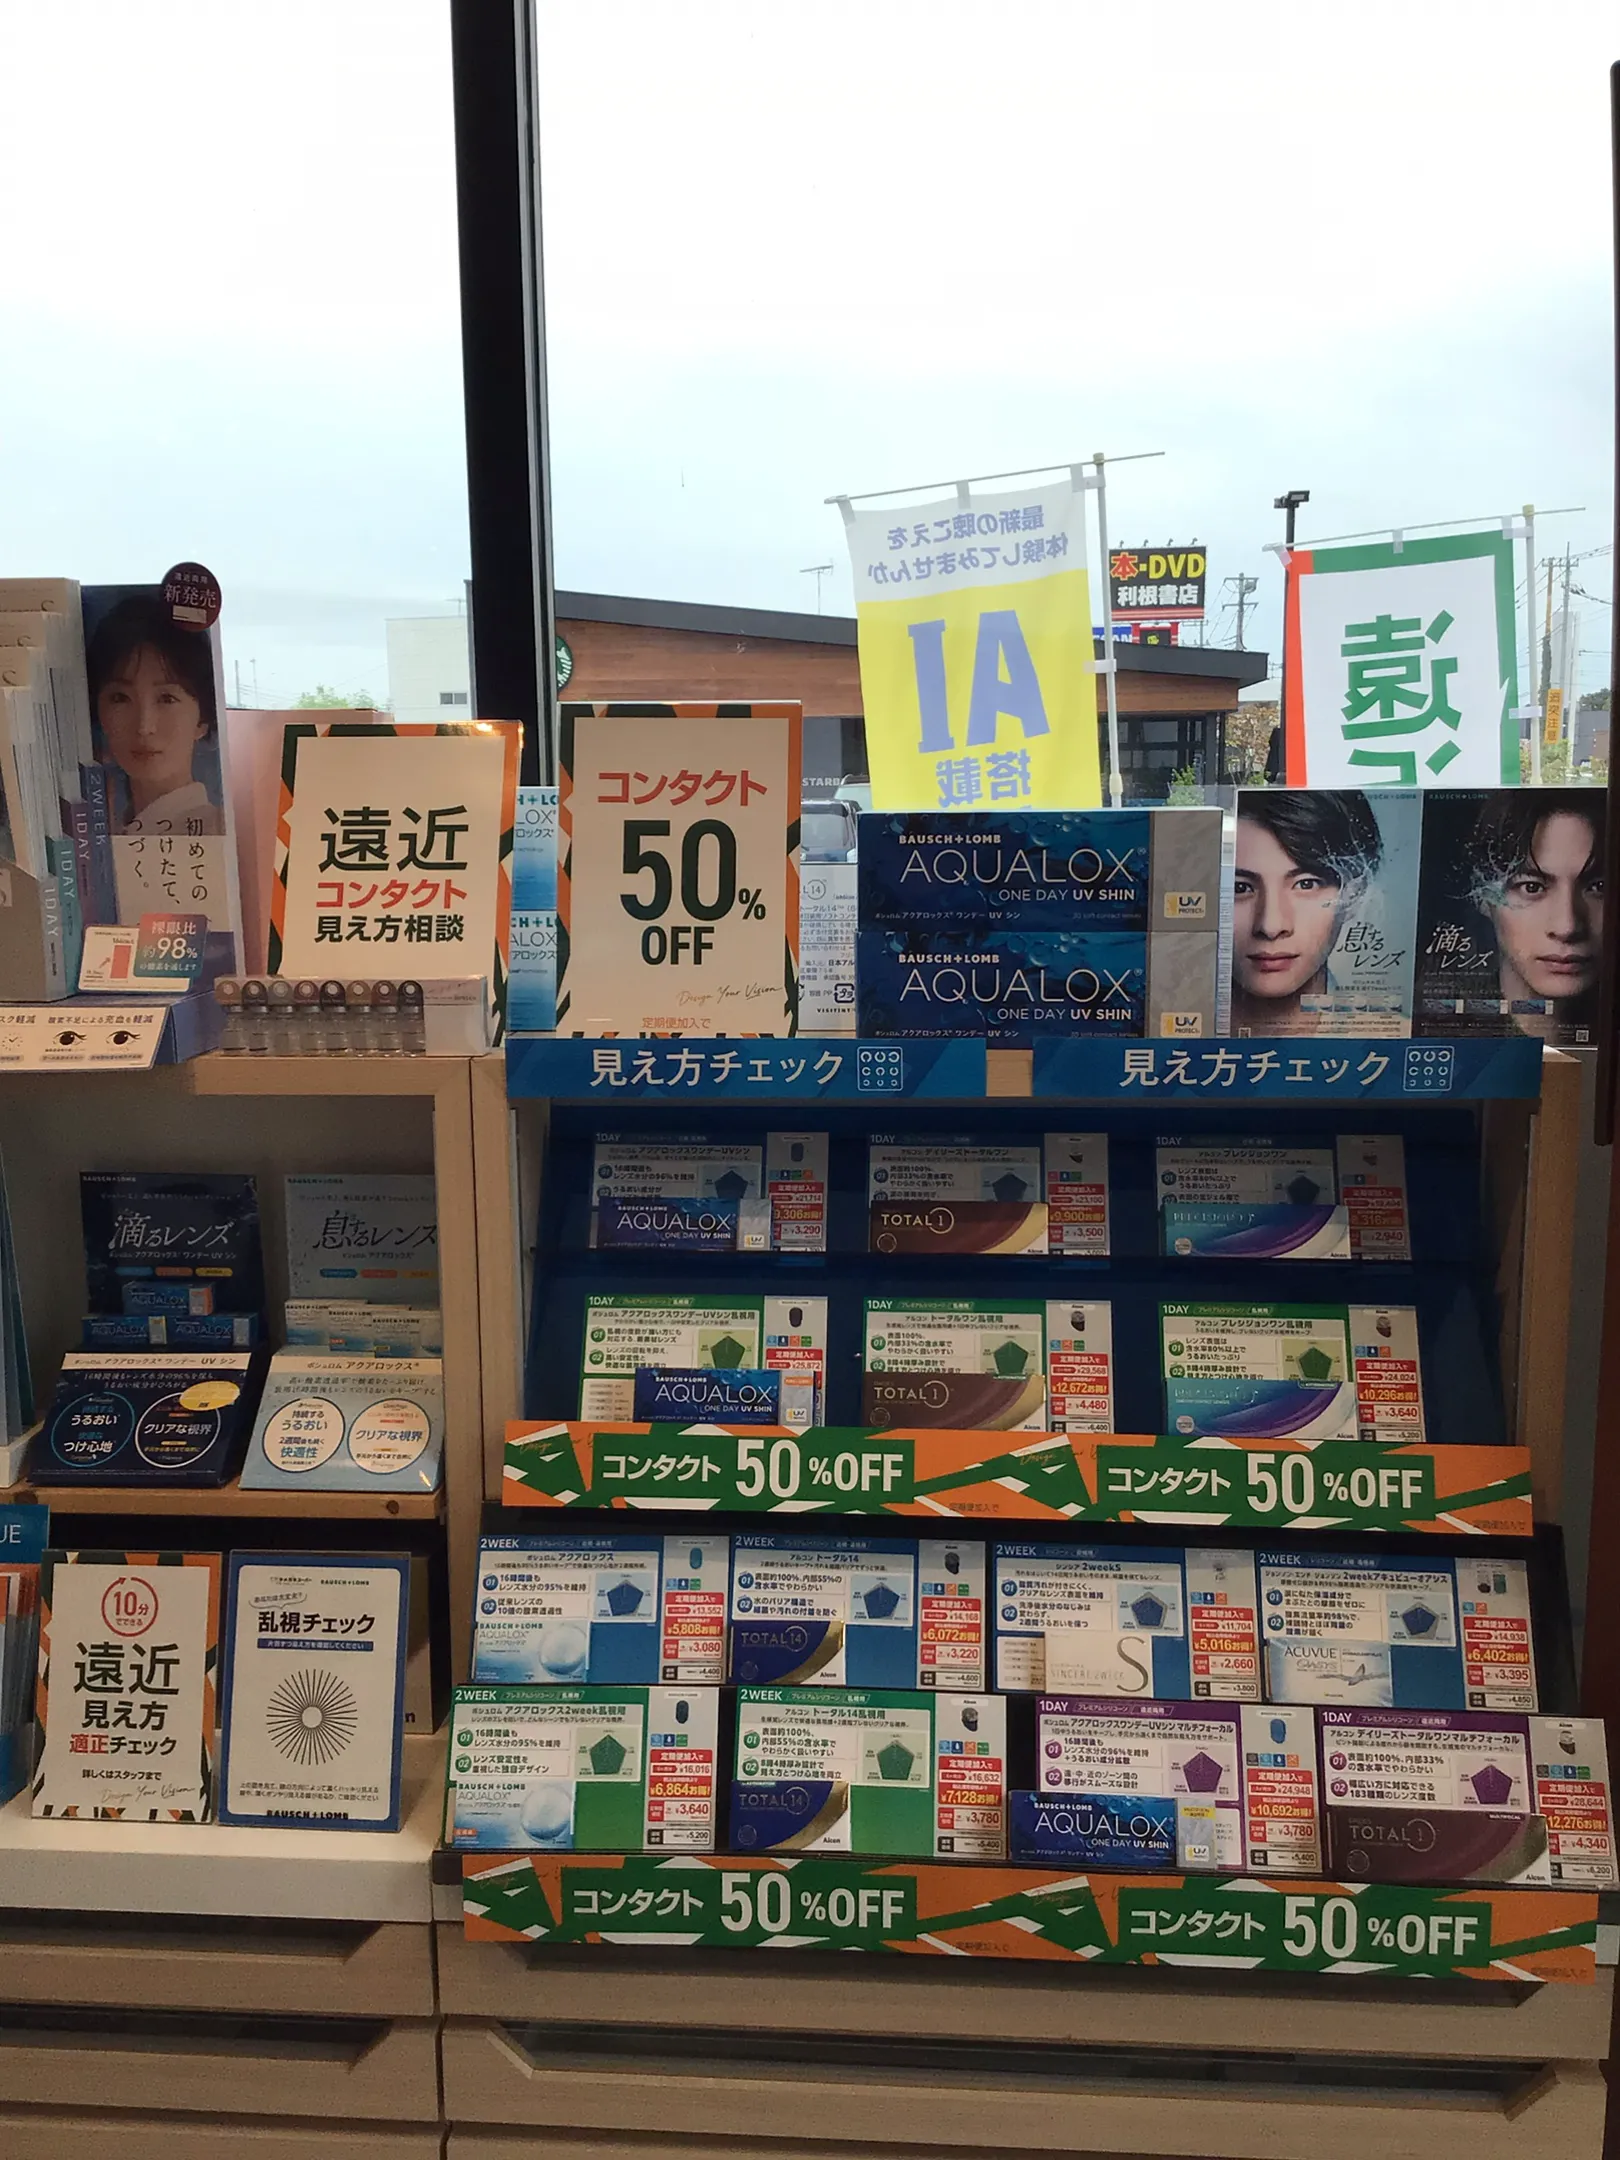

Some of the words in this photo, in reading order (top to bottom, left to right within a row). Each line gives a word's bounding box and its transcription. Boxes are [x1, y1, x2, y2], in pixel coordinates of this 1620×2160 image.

[164, 584, 217, 609] 新発売
[1117, 583, 1199, 607] 利根書店
[597, 770, 768, 806] コンタクト
[318, 805, 469, 873] 遠近
[899, 834, 1001, 845] BAUSCH+LOMB
[185, 816, 208, 901] 初めての
[314, 880, 467, 909] コンタクト
[999, 889, 1031, 901] ONE
[1036, 889, 1068, 901] DAY
[1073, 889, 1094, 901] UV
[1098, 889, 1135, 901] SHIN
[314, 915, 464, 943] 見え方相談
[641, 926, 714, 965] OFF
[899, 954, 1000, 964] BAUSCH+LOMB
[997, 1009, 1029, 1020] ONE
[1034, 1009, 1066, 1020] DAY
[1070, 1009, 1091, 1020] UV
[1096, 1009, 1132, 1020] SHIN
[642, 1017, 711, 1029] 定期便加入で
[590, 1048, 843, 1087] 見え方チェック
[1119, 1048, 1390, 1086] 見え方チェック
[1156, 1137, 1182, 1145] 1DAY
[589, 1296, 614, 1305] 1DAY
[867, 1300, 893, 1309] 1DAY
[1162, 1305, 1189, 1314] 1DAY
[874, 1387, 927, 1400] TOTAL
[71, 1414, 118, 1426] うるおい
[281, 1420, 327, 1431] うるおい
[144, 1424, 213, 1436] クリアな視界
[356, 1430, 423, 1442] クリアな視界
[603, 1454, 722, 1483] コンタクト
[1107, 1466, 1231, 1497] コンタクト
[481, 1538, 520, 1548] 2WEEK
[735, 1537, 775, 1547] 2WEEK
[996, 1545, 1037, 1556] 2WEEK
[558, 1553, 614, 1562] アクアロックス
[1259, 1553, 1301, 1565] 2WEEK
[258, 1612, 376, 1635] 乱視チェック
[1284, 1647, 1337, 1659] ACUVUE
[74, 1642, 180, 1695] 遠近
[455, 1690, 497, 1701] 2WEEK
[741, 1689, 782, 1701] 2WEEK
[1040, 1701, 1068, 1712] 1DAY
[82, 1700, 168, 1730] 見え方
[1322, 1712, 1352, 1723] 1DAY
[69, 1733, 178, 1756] 適正チェック
[82, 1769, 162, 1781] 詳しくはスタッフまで
[1091, 1839, 1109, 1848] ONE
[1111, 1840, 1131, 1849] DAY
[1133, 1840, 1146, 1849] UV
[1148, 1840, 1169, 1850] SHIN
[574, 1889, 704, 1917] コンタクト
[1130, 1909, 1266, 1940] コンタクト
